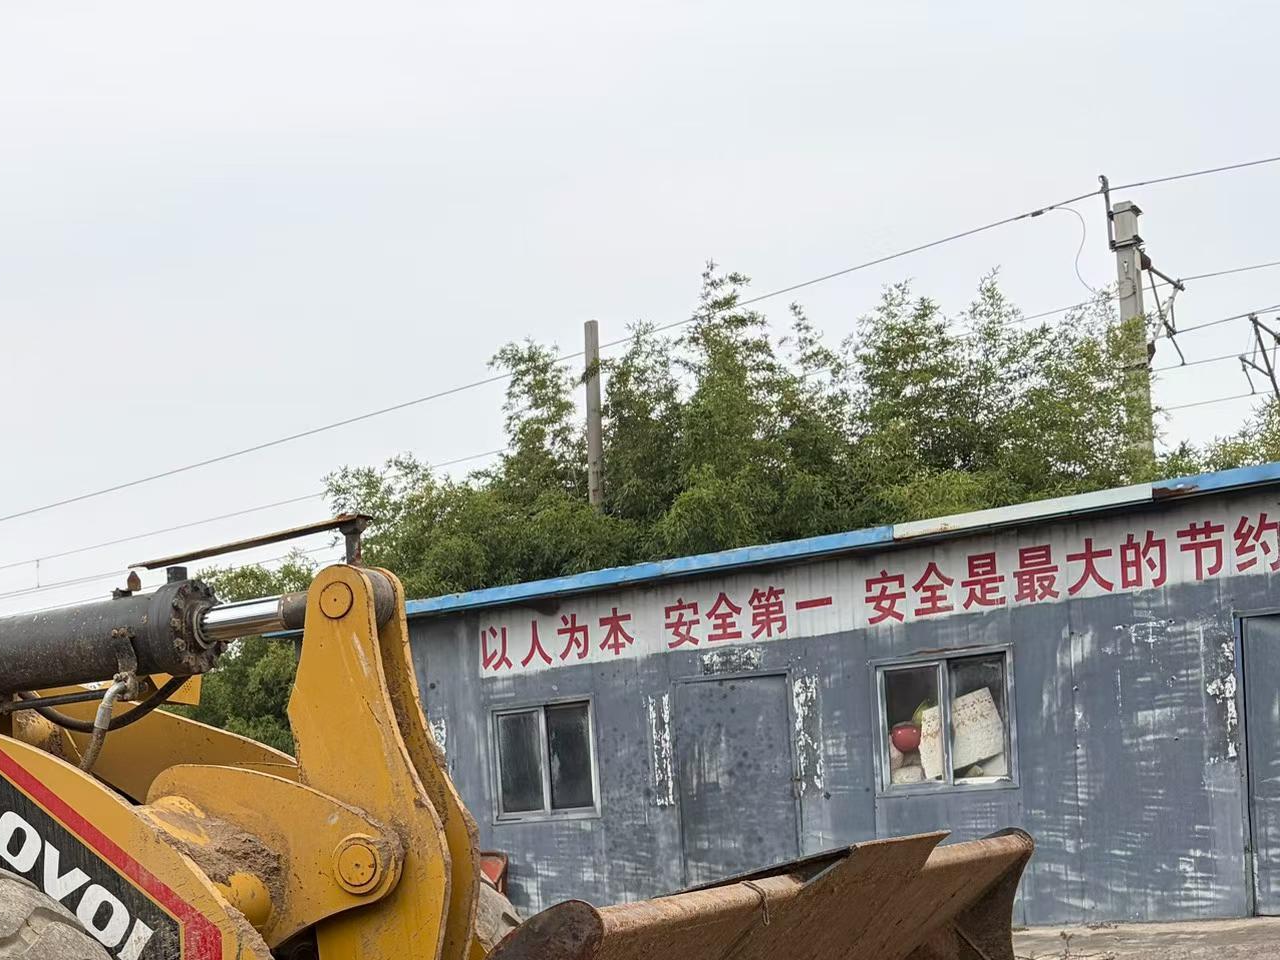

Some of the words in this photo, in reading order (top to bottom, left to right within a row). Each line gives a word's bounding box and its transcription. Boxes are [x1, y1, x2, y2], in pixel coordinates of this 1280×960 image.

[481, 608, 634, 671] 以人为本
[664, 586, 833, 648] 安全第一
[865, 513, 1280, 624] 安全是最大的节约
